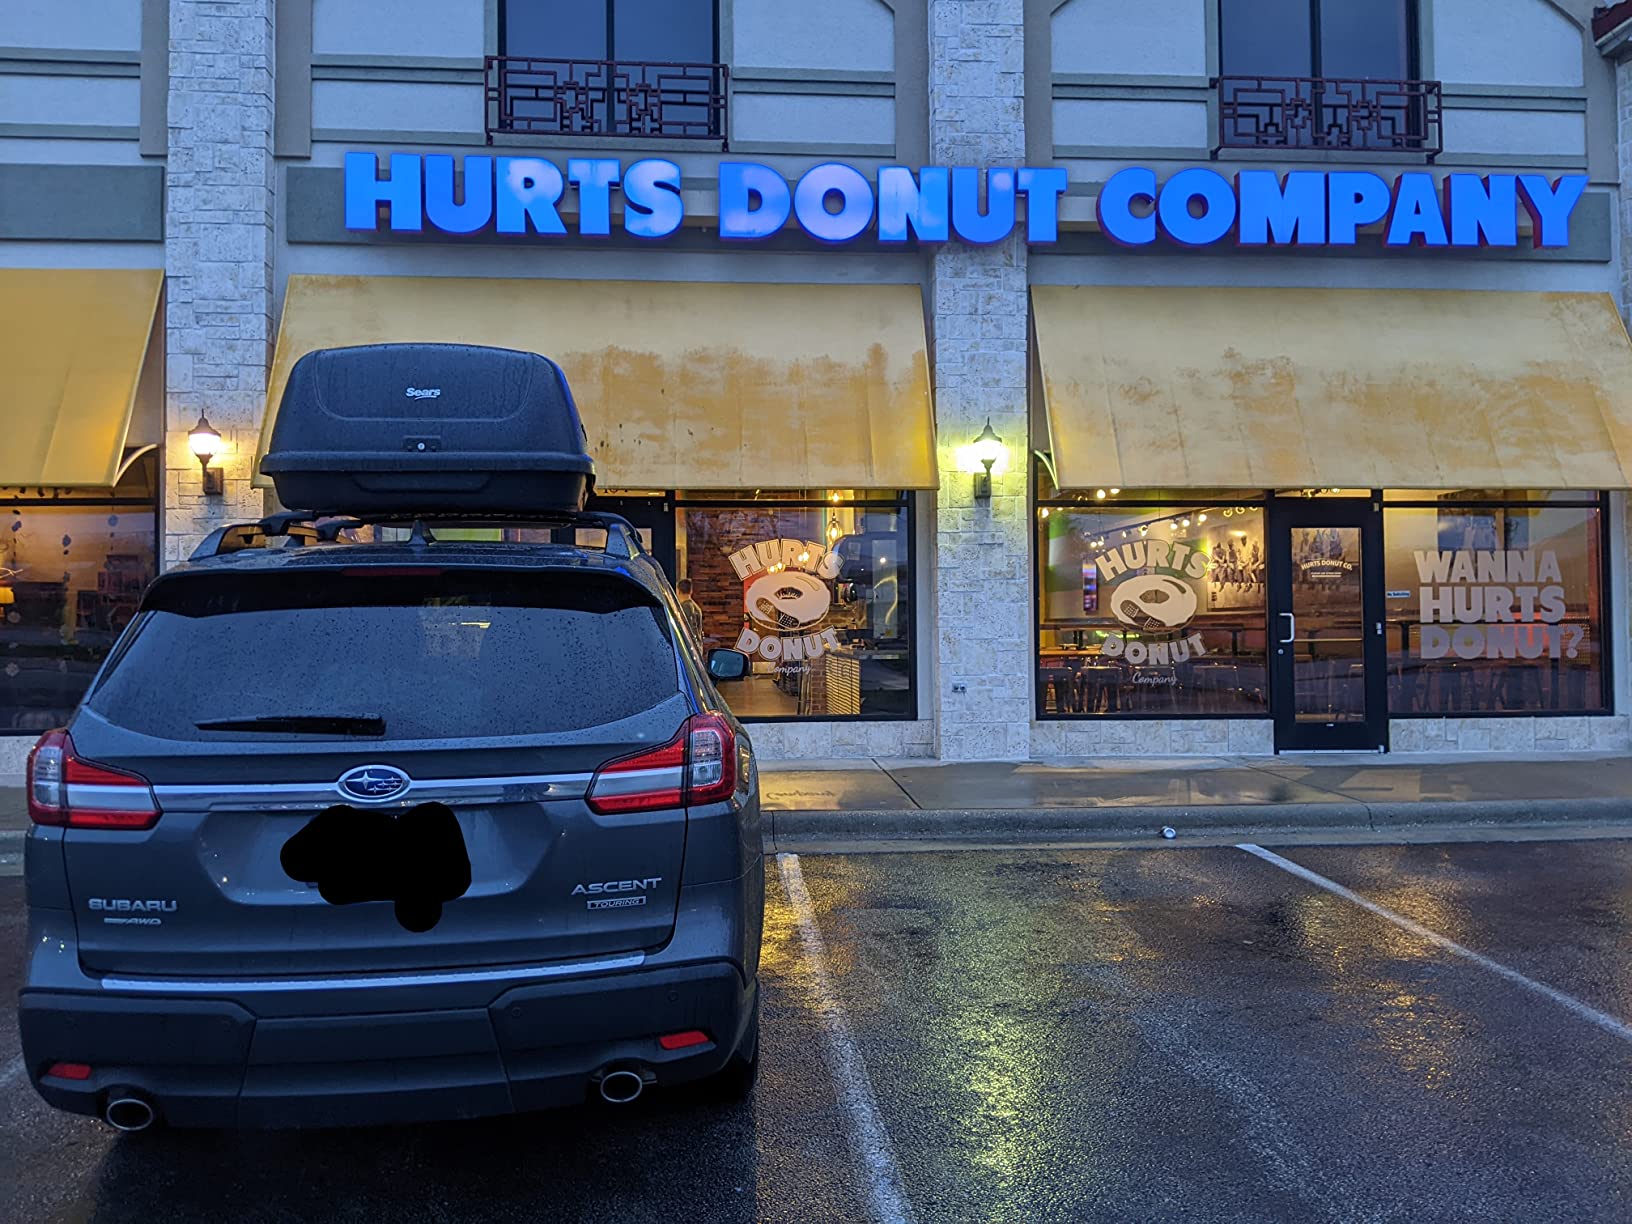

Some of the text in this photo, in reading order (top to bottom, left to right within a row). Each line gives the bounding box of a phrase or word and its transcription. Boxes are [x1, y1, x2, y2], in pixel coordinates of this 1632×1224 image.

[344, 151, 1590, 248] HURTS DONUT COMPANY
[406, 387, 441, 399] Sears
[728, 538, 844, 581] HURTS
[1094, 539, 1213, 582] HURTS
[1301, 560, 1321, 571] HURTS
[1413, 550, 1562, 583] WANNA
[1419, 586, 1567, 624] HURTS
[734, 625, 839, 661] DONUT
[1101, 632, 1208, 665] DONUT
[1420, 624, 1585, 660] DONUT?
[1132, 670, 1177, 686] Company
[571, 877, 662, 895] ASCENT
[88, 898, 177, 912] SUBARU
[594, 898, 640, 909] TOURING
[126, 917, 162, 925] AWD
